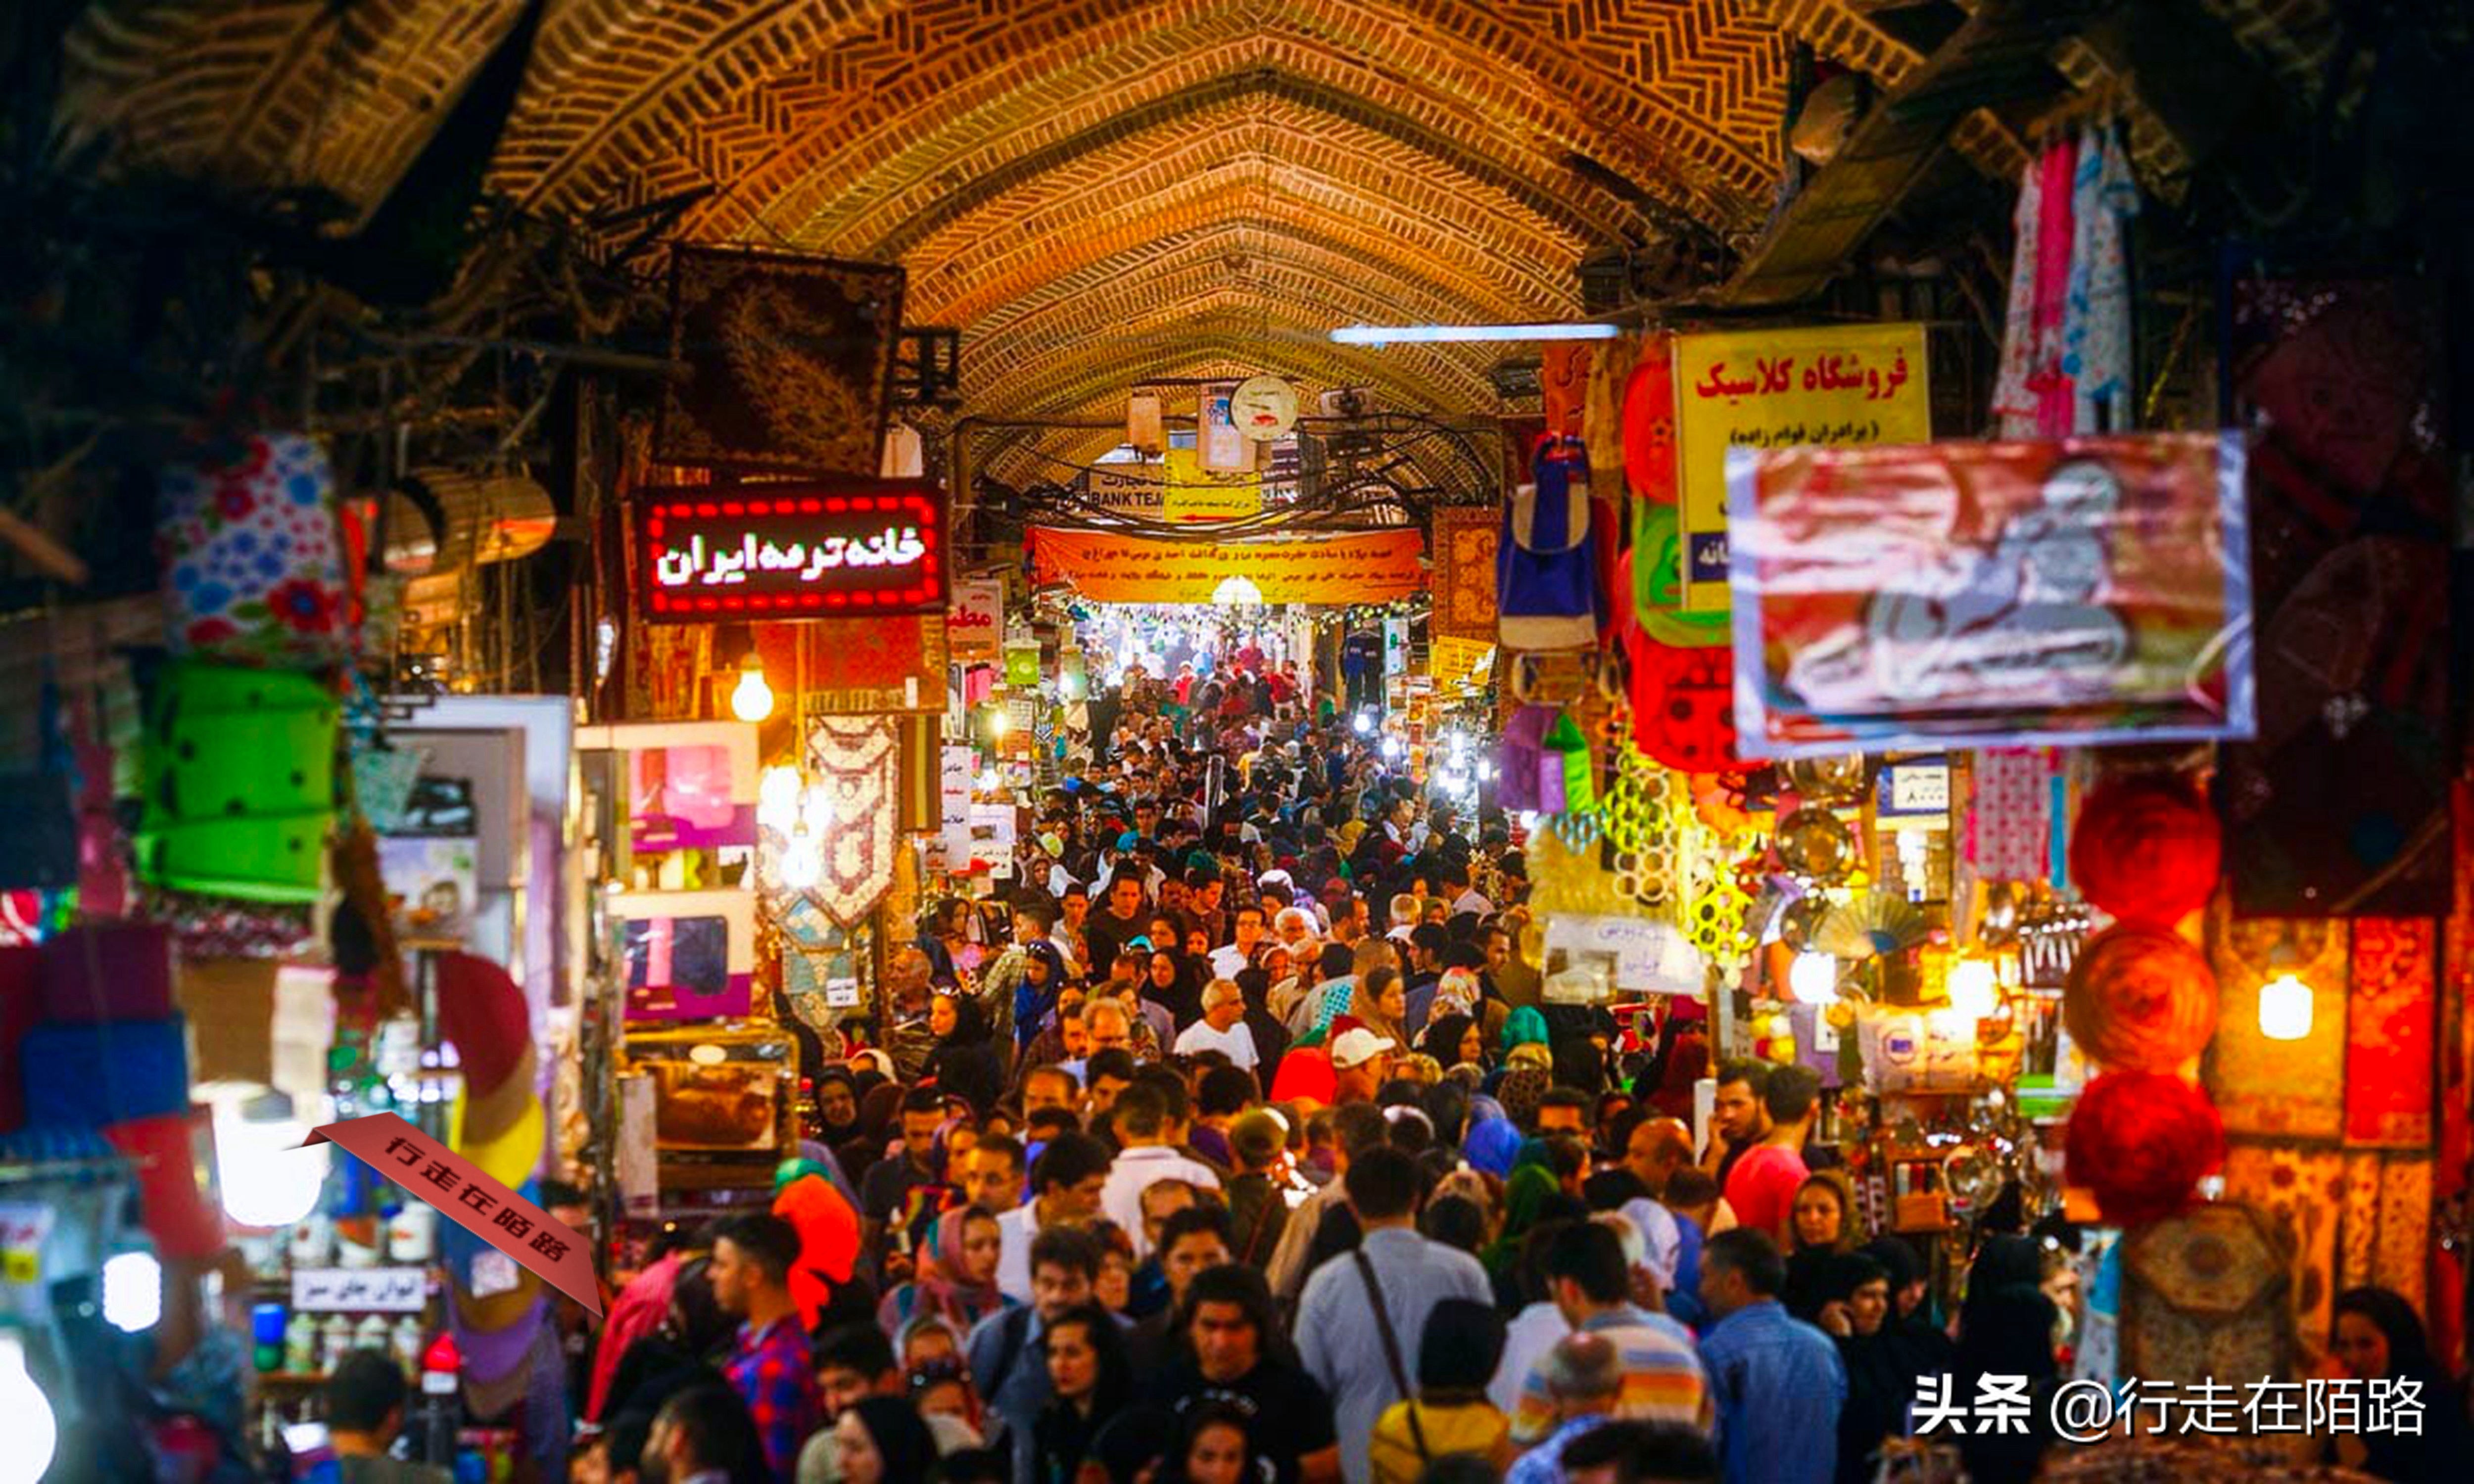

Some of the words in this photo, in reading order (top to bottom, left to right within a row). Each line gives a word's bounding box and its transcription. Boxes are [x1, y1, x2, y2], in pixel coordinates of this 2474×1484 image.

[1695, 356, 1794, 405] کلاسیک
[1803, 347, 1908, 400] فروشگاه
[1091, 492, 1132, 506] BANK
[657, 533, 758, 586] ایران
[758, 537, 847, 581] ترمه
[845, 526, 925, 564] خانه
